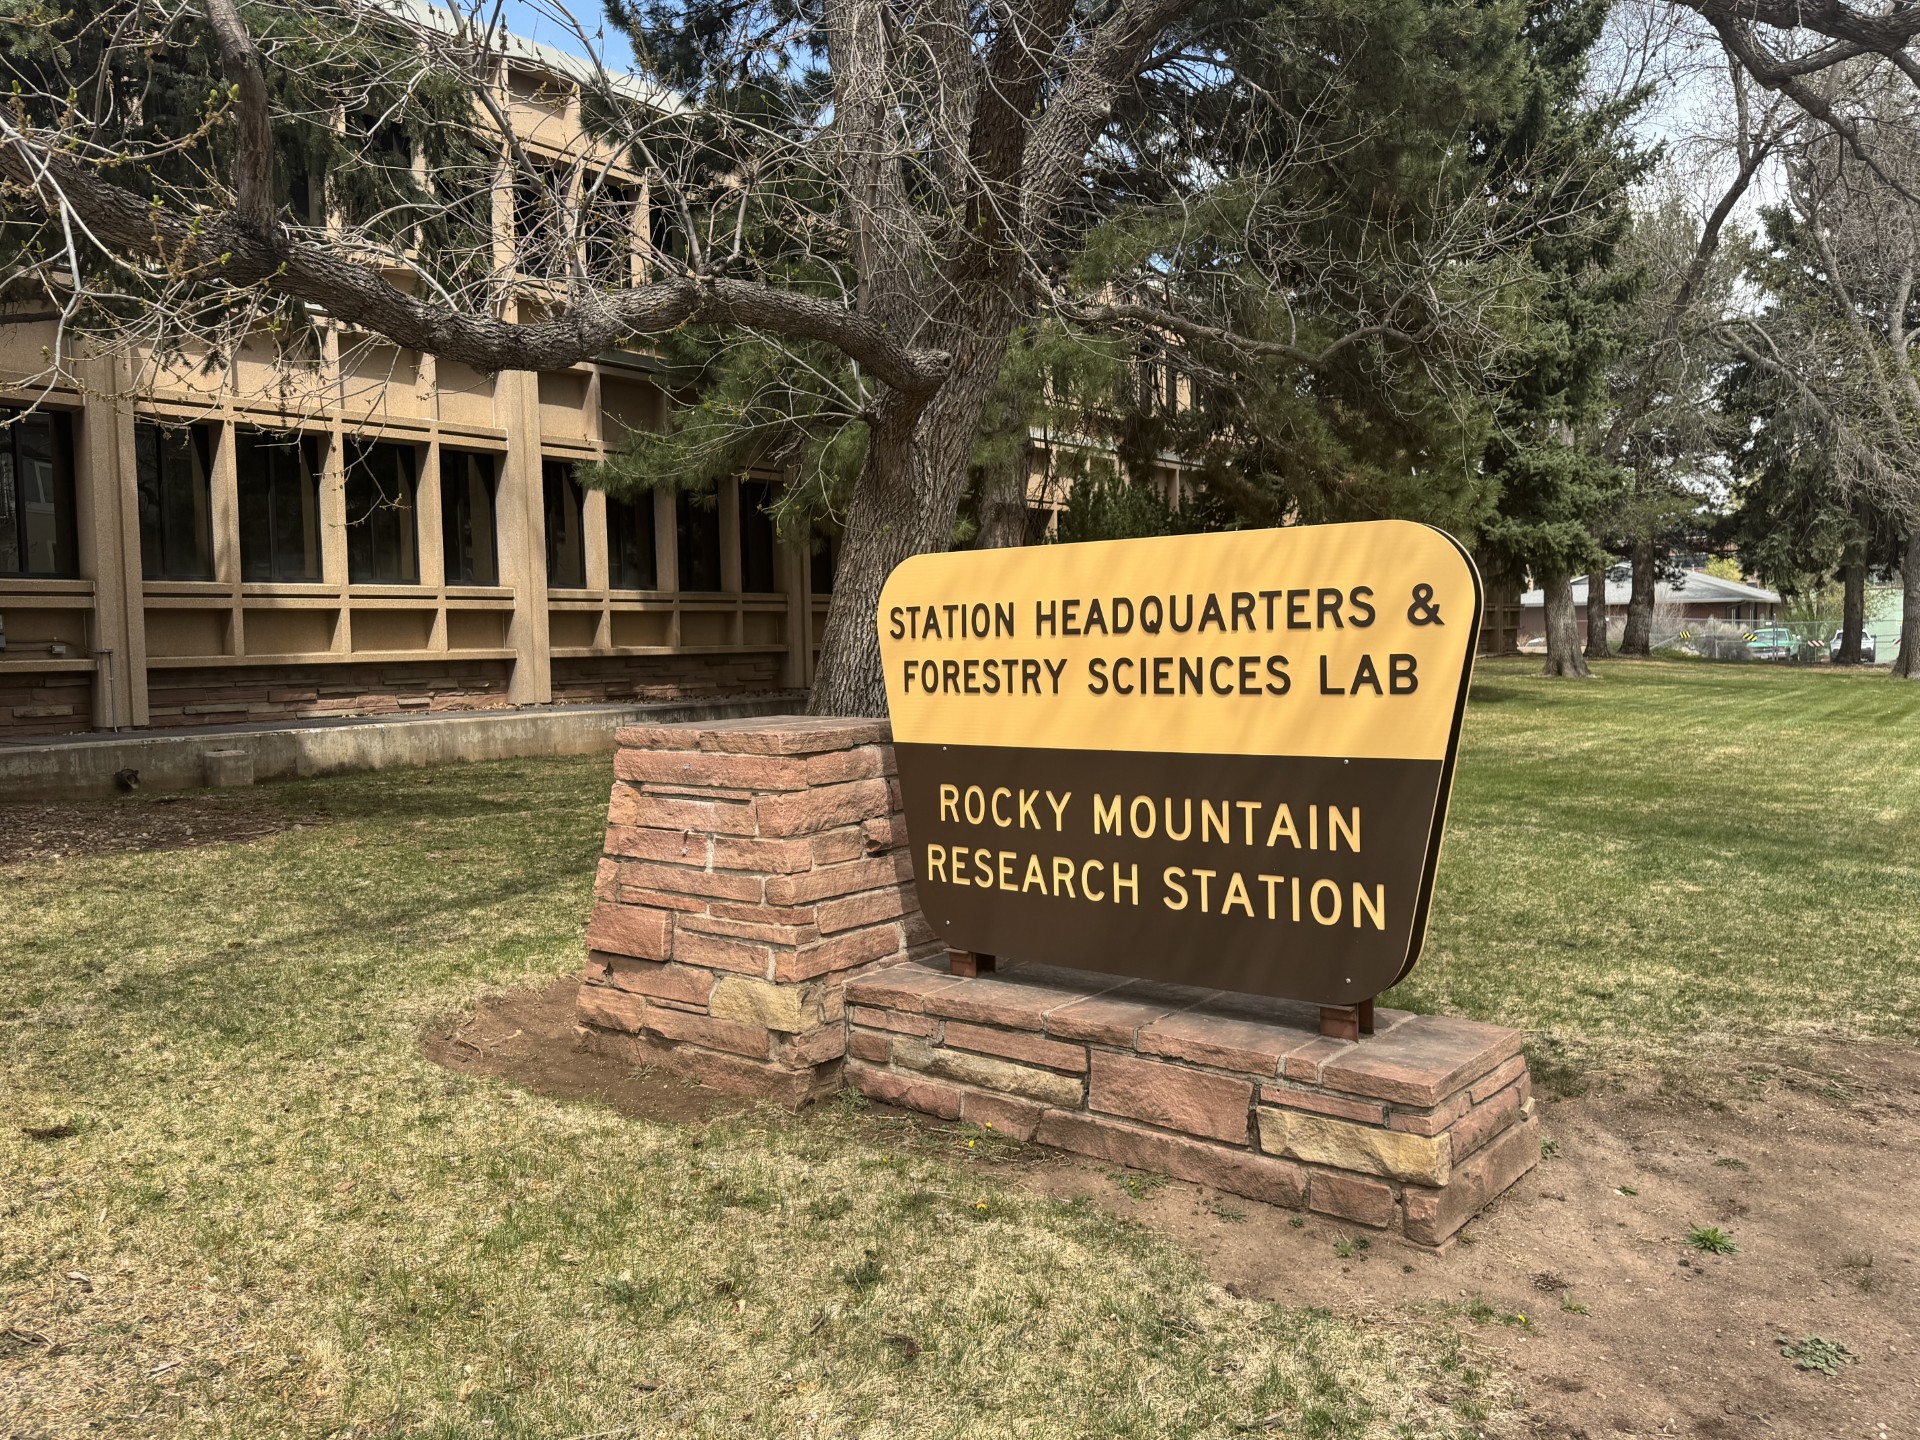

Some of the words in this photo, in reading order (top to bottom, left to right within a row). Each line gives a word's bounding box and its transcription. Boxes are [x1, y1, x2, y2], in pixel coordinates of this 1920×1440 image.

[889, 602, 1014, 639] STATION
[1036, 586, 1376, 635] HEADQUARTERS
[1407, 583, 1445, 626] &
[903, 658, 1068, 694] FORESTRY
[1087, 655, 1292, 695] SCIENCES
[1319, 654, 1419, 695] LAB
[940, 783, 1072, 832] ROCKY
[1093, 794, 1361, 853] MOUNTAIN
[927, 844, 1139, 906] RESEARCH
[1162, 866, 1386, 930] STATION
